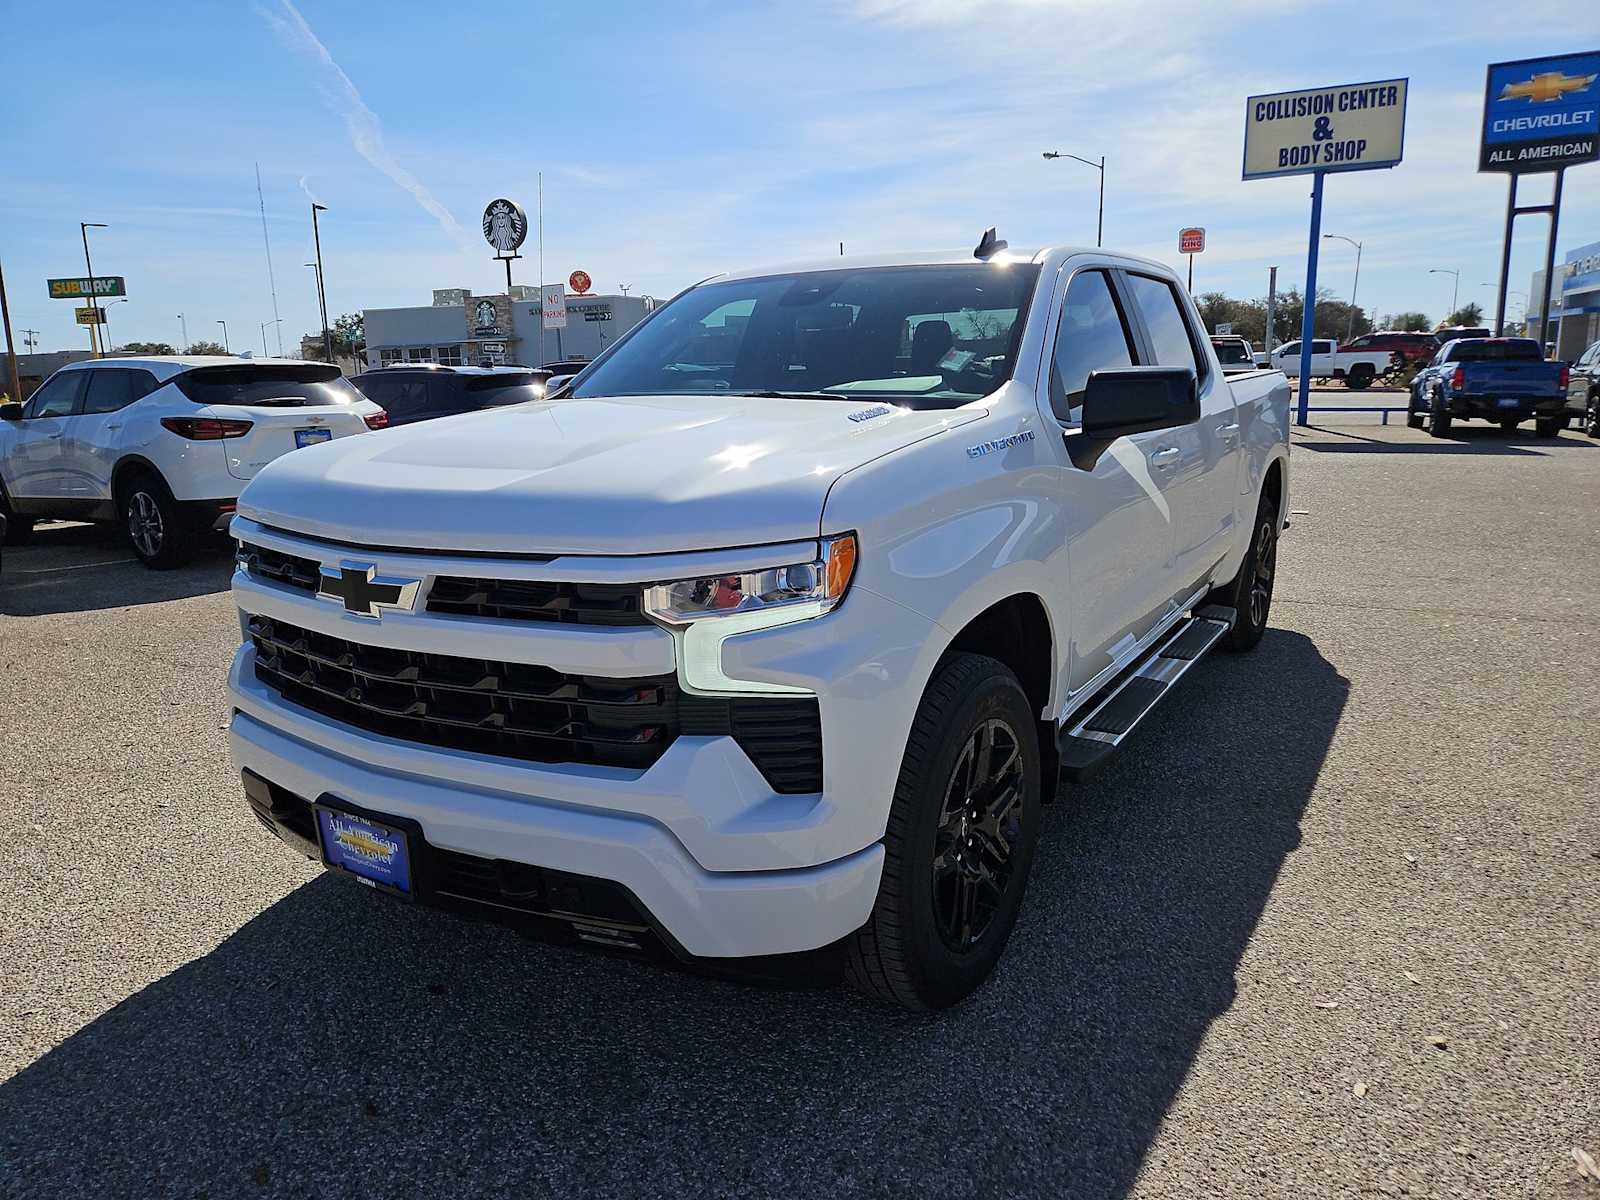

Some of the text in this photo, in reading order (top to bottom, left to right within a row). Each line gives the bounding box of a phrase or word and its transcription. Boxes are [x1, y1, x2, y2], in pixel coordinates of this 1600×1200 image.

[1255, 86, 1398, 122] COLLISION CENTER
[1312, 116, 1334, 141] &
[1492, 110, 1595, 133] CHEVROLET
[1278, 139, 1367, 167] BODY SHOP
[1488, 142, 1593, 163] ALL AMERICAN
[52, 280, 113, 295] SUBWAY
[547, 294, 559, 304] NO
[329, 819, 344, 831] All
[347, 825, 399, 852] American
